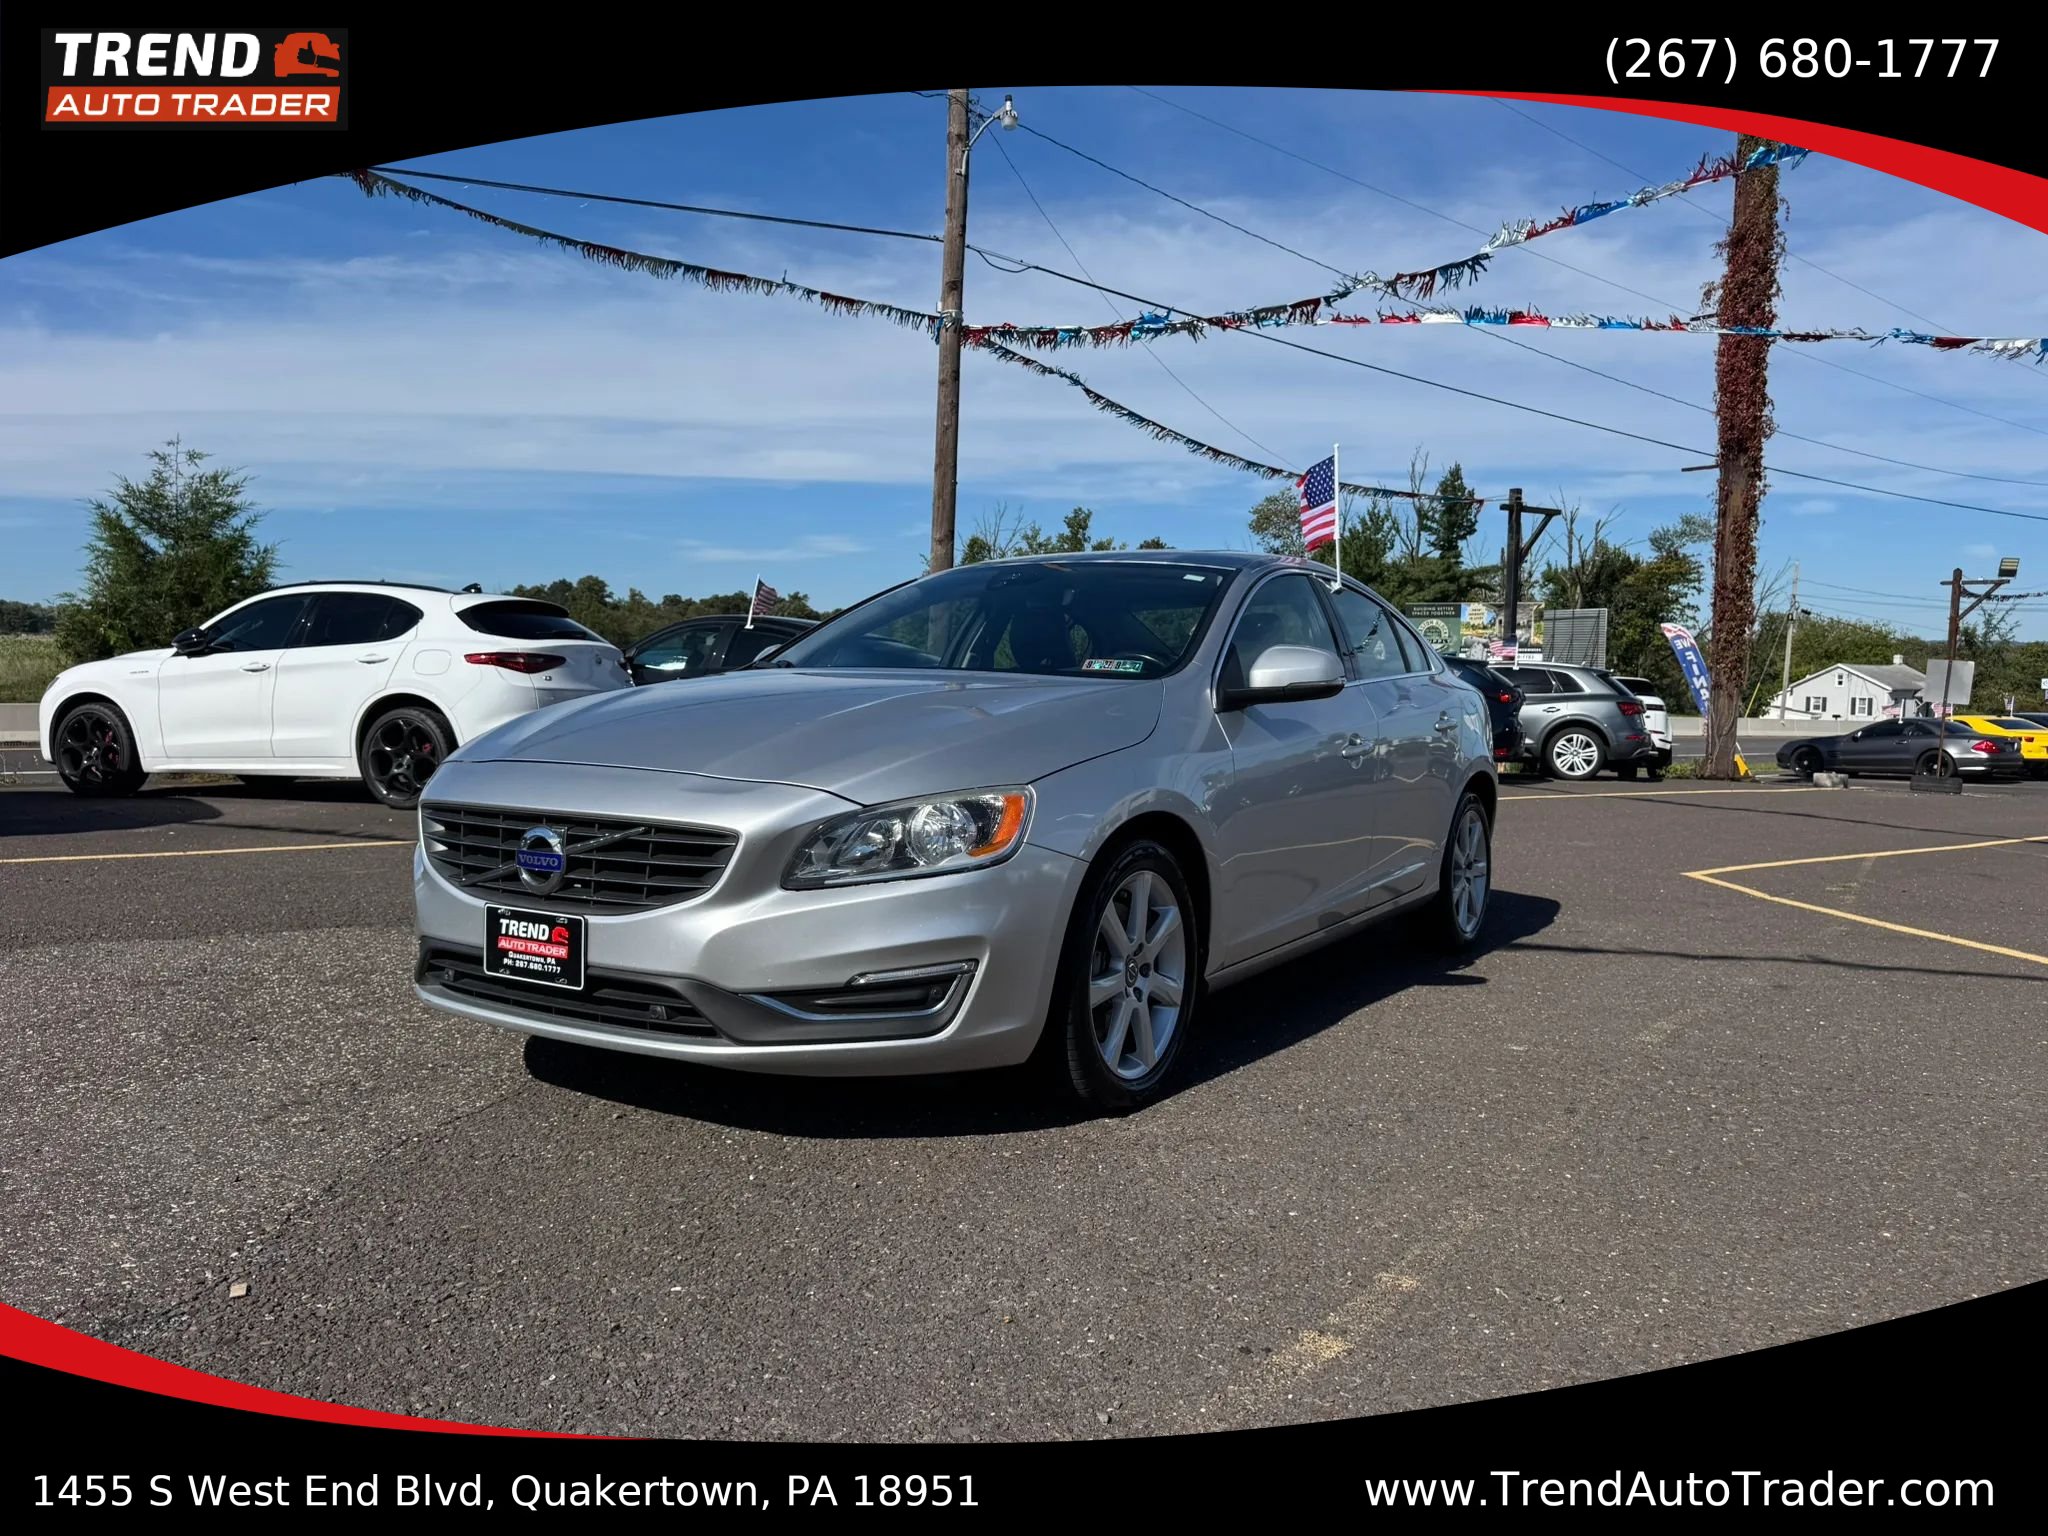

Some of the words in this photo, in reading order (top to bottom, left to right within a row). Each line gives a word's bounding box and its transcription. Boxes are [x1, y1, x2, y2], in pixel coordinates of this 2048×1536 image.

[518, 854, 559, 867] VOLVO
[500, 918, 549, 941] TREND
[500, 939, 526, 951] AUTO
[527, 942, 567, 957] TRADER
[515, 959, 561, 974] 267.680.1777
[546, 957, 556, 965] PA
